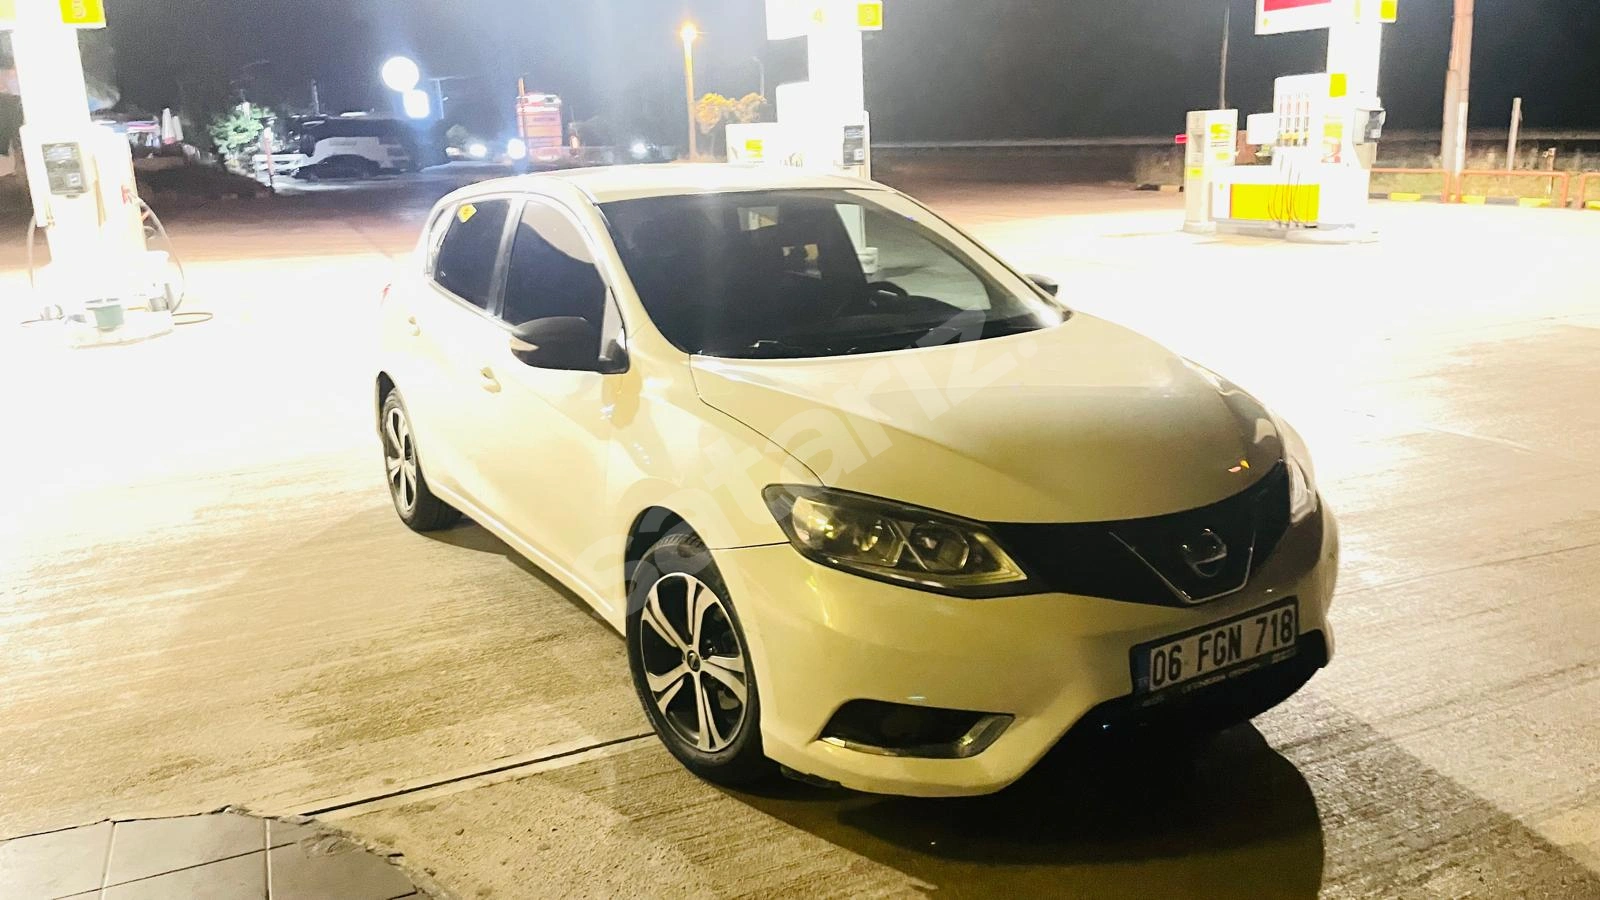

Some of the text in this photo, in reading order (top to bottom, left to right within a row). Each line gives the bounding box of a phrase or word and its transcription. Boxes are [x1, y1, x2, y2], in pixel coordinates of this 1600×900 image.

[1152, 644, 1182, 687] 06
[1197, 625, 1242, 672] FGN
[1255, 609, 1293, 653] 718
